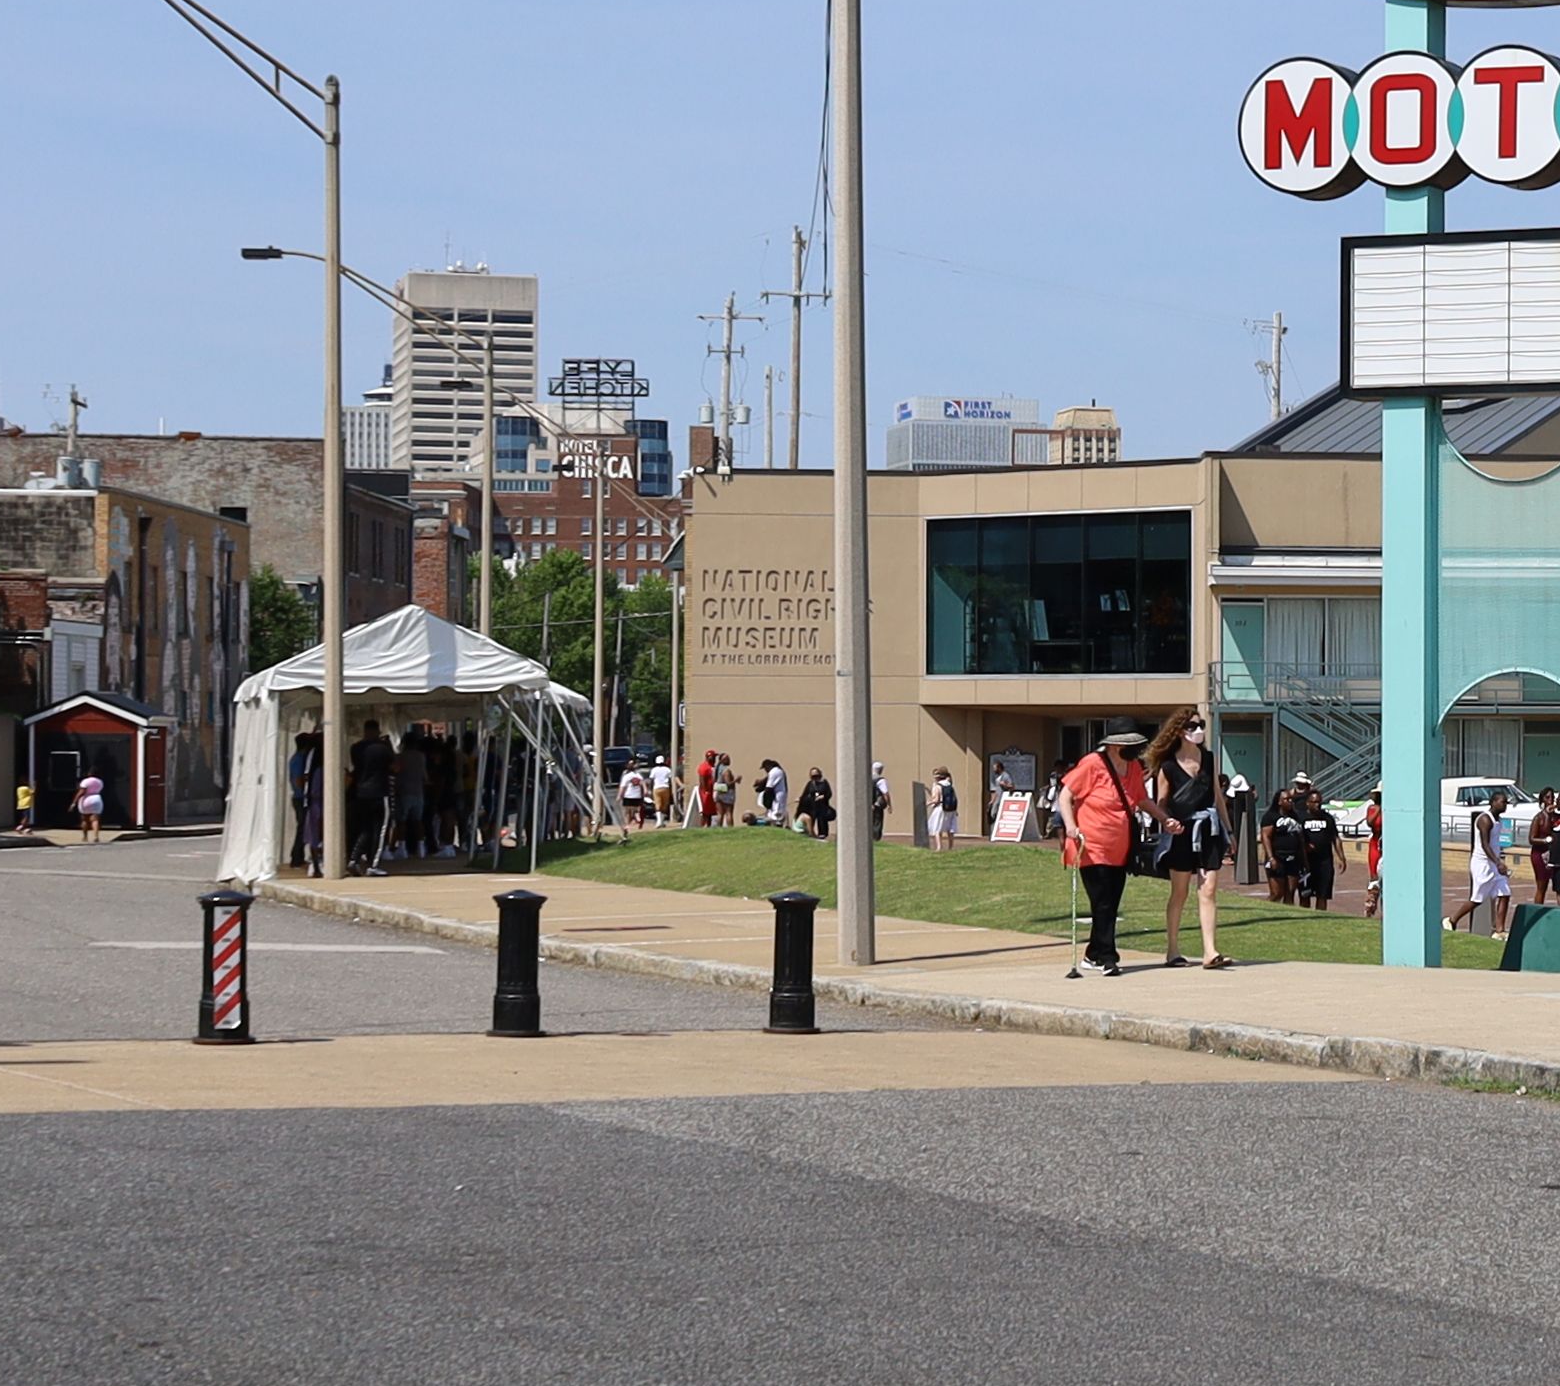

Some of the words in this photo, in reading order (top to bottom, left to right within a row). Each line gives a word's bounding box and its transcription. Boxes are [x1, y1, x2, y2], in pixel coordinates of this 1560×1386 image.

[964, 401, 992, 410] FIRST
[964, 410, 1011, 419] HORIZON
[702, 569, 835, 592] NATIONAL
[702, 598, 772, 620] CIVIL
[778, 598, 874, 621] RIGH
[702, 627, 820, 649] MUSEUM
[702, 654, 718, 664] AT
[721, 654, 744, 664] THE
[747, 654, 810, 665] LORRAINE
